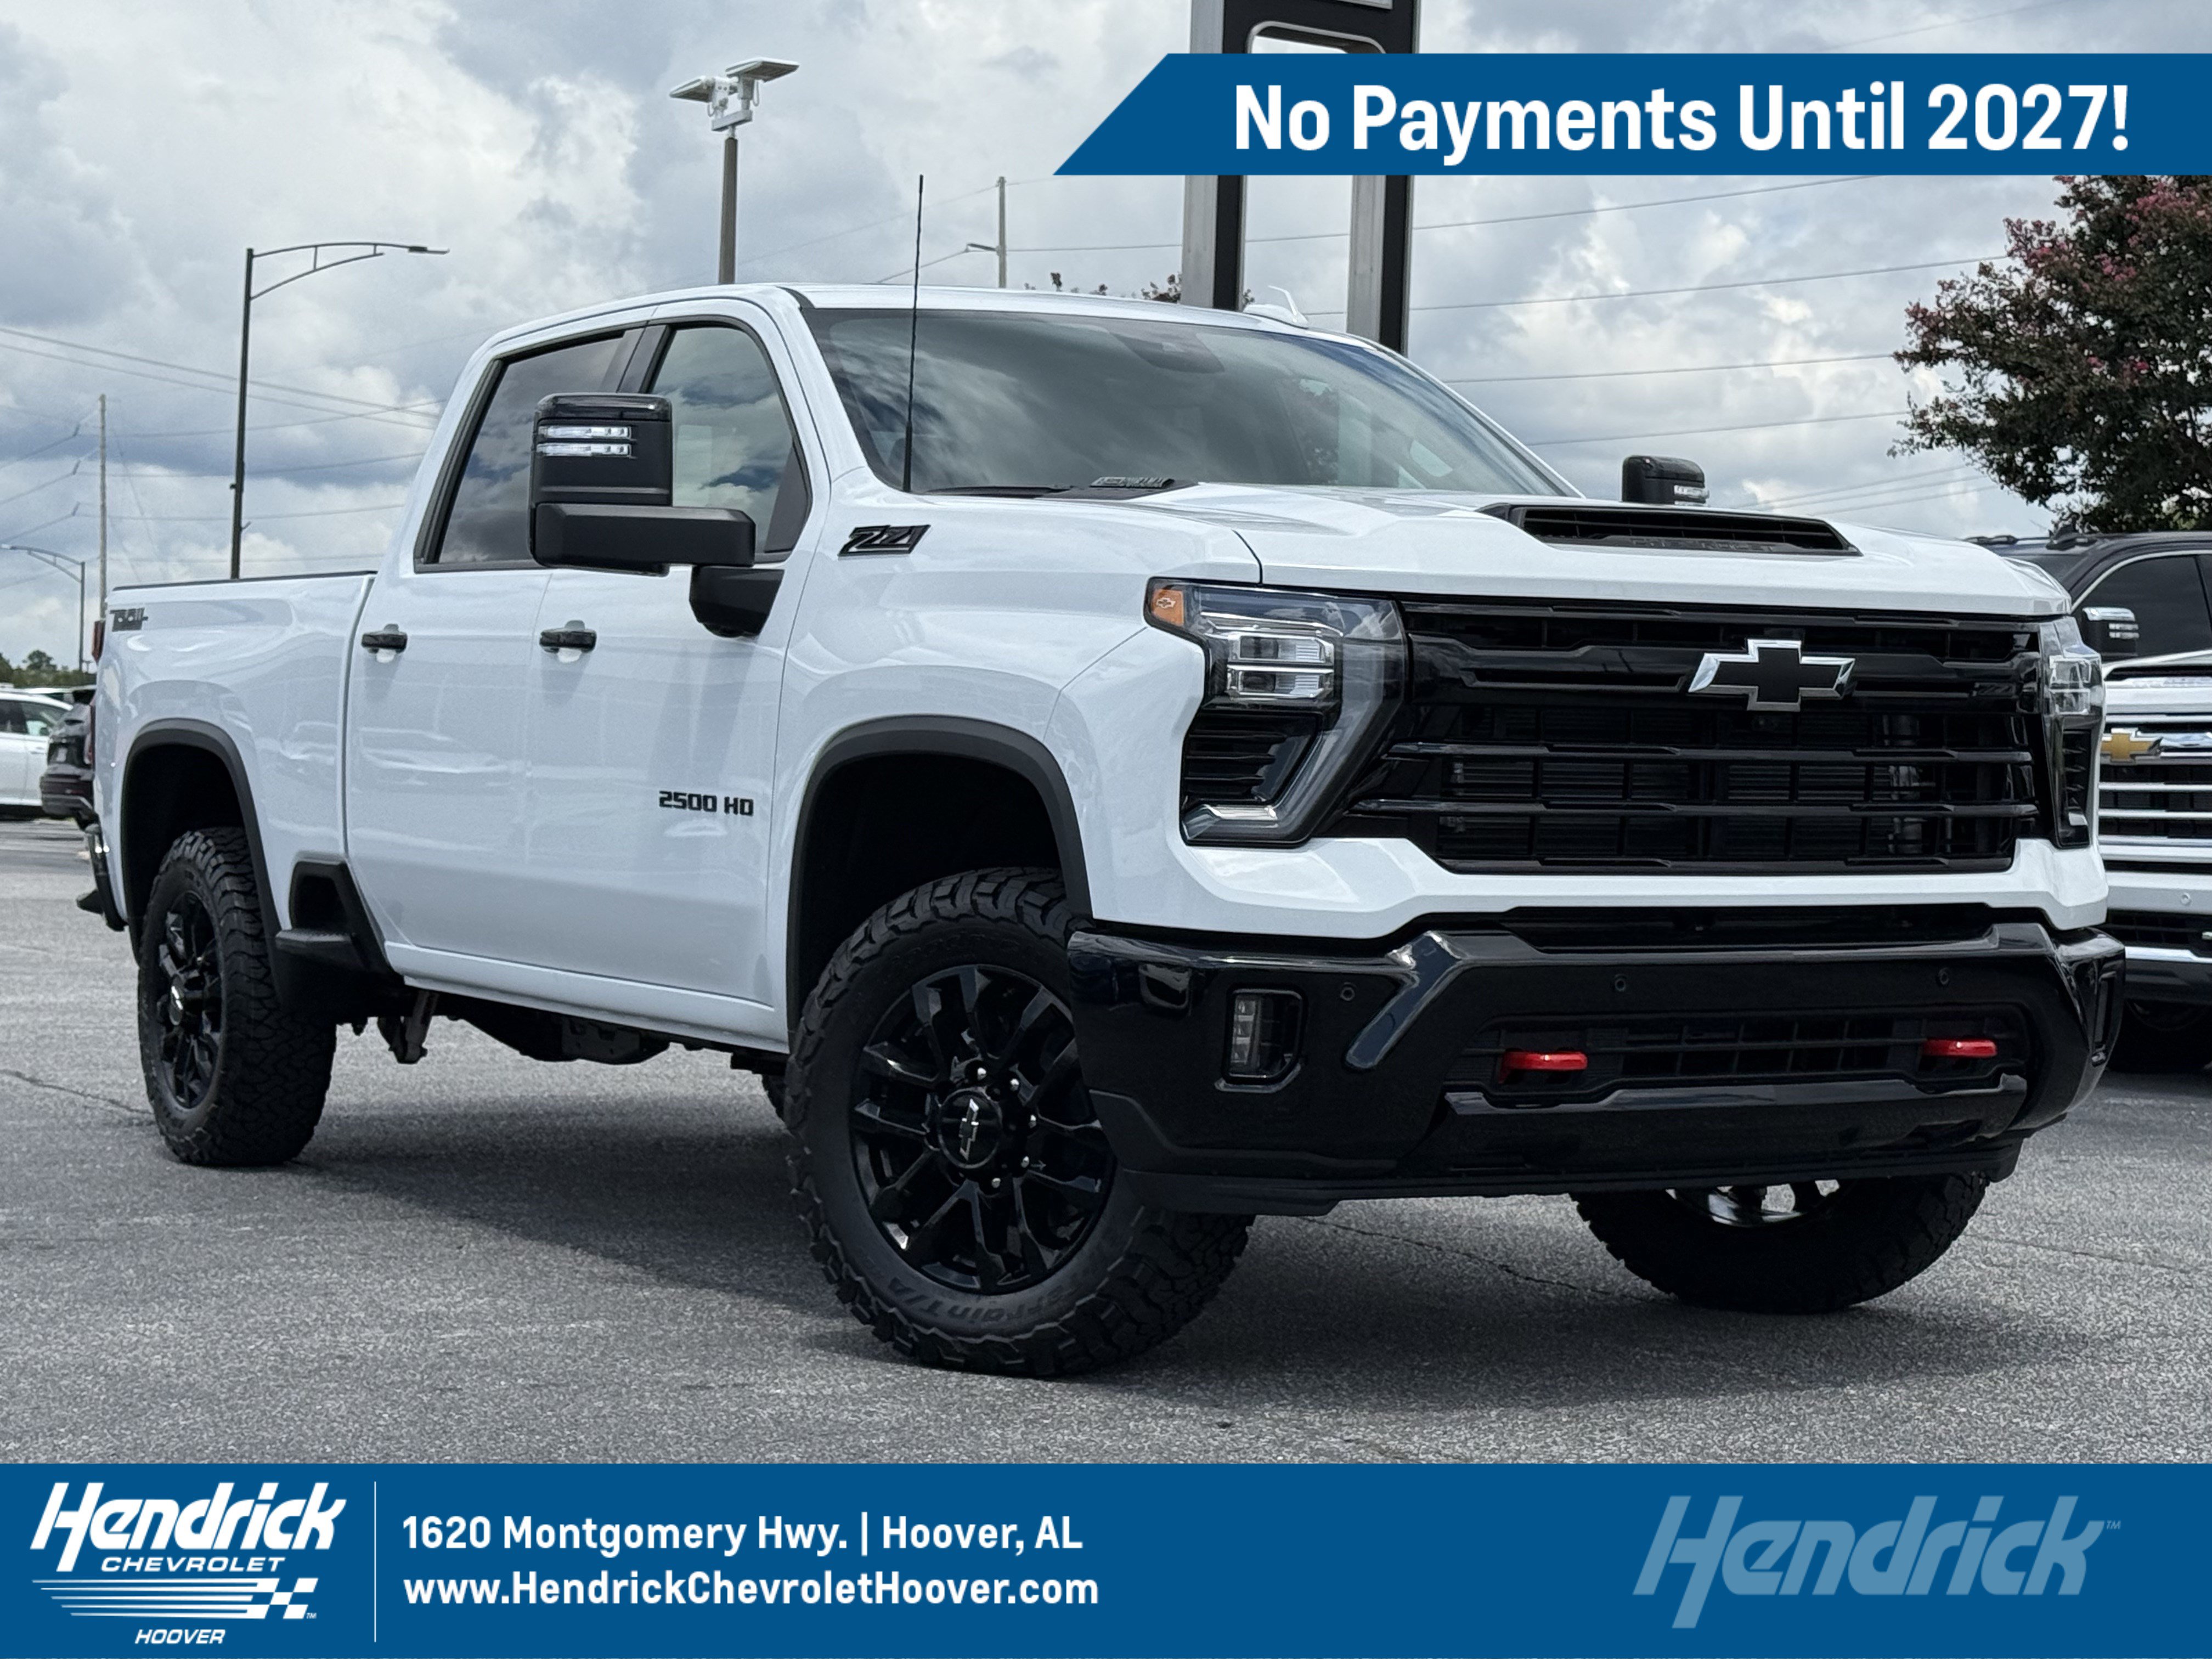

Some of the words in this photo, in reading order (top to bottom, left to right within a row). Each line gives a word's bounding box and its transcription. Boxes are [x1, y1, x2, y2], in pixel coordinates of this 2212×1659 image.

[838, 524, 932, 556] Z71
[659, 790, 718, 812] 2500
[724, 796, 754, 817] HD
